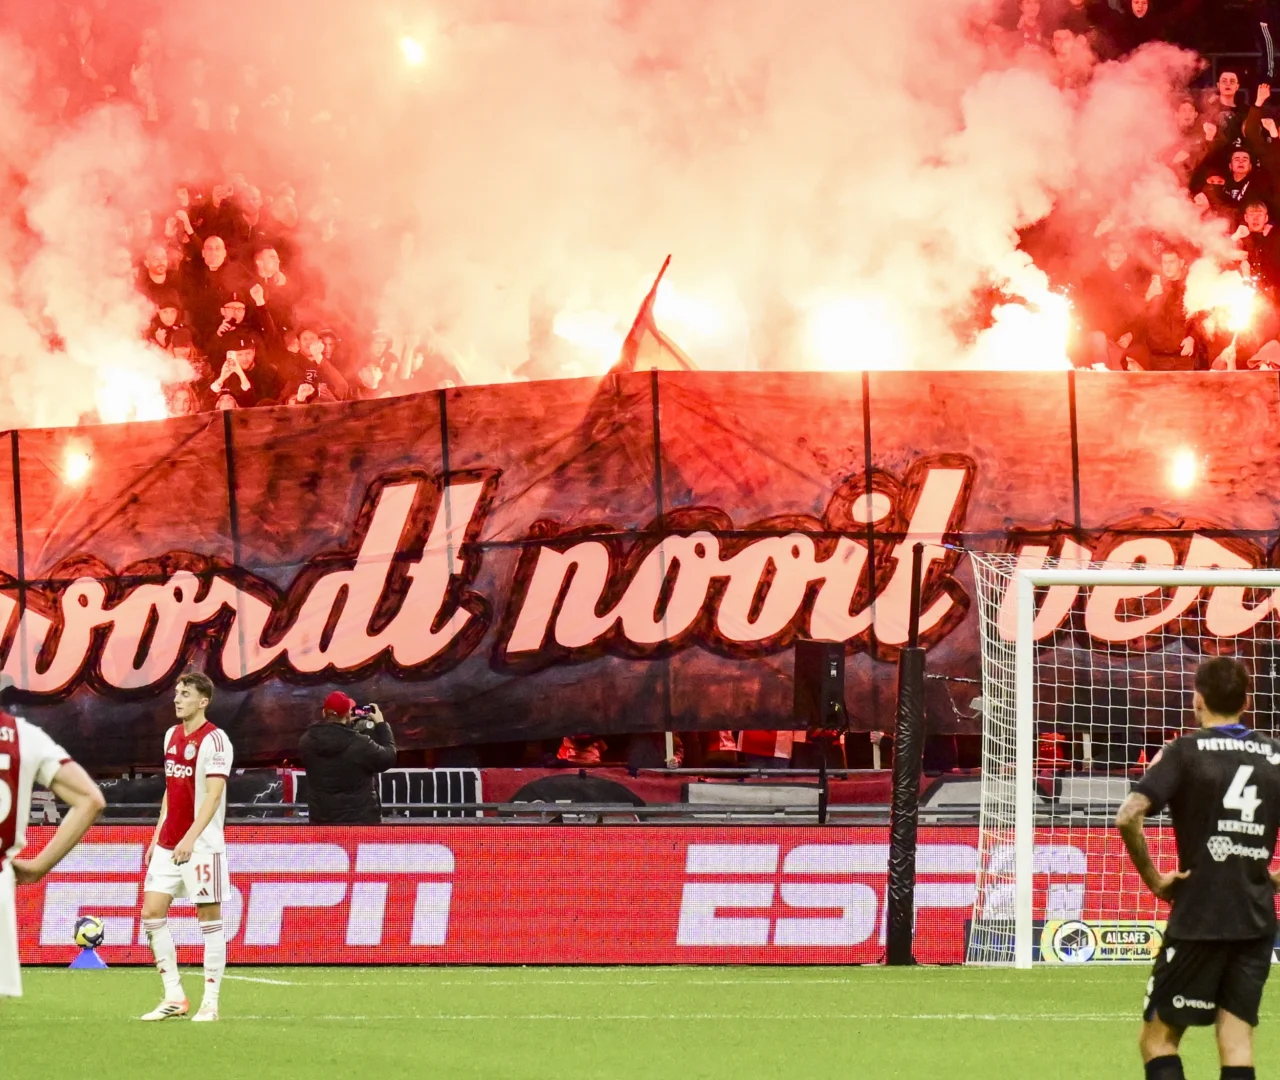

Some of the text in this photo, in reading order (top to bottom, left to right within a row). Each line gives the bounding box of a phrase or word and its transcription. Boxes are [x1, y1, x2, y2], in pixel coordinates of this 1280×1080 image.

[507, 468, 967, 652] nooit
[1223, 764, 1262, 822] 4
[195, 864, 211, 884] 15
[1105, 930, 1147, 944] ALLSAFE
[1100, 947, 1118, 956] MINI
